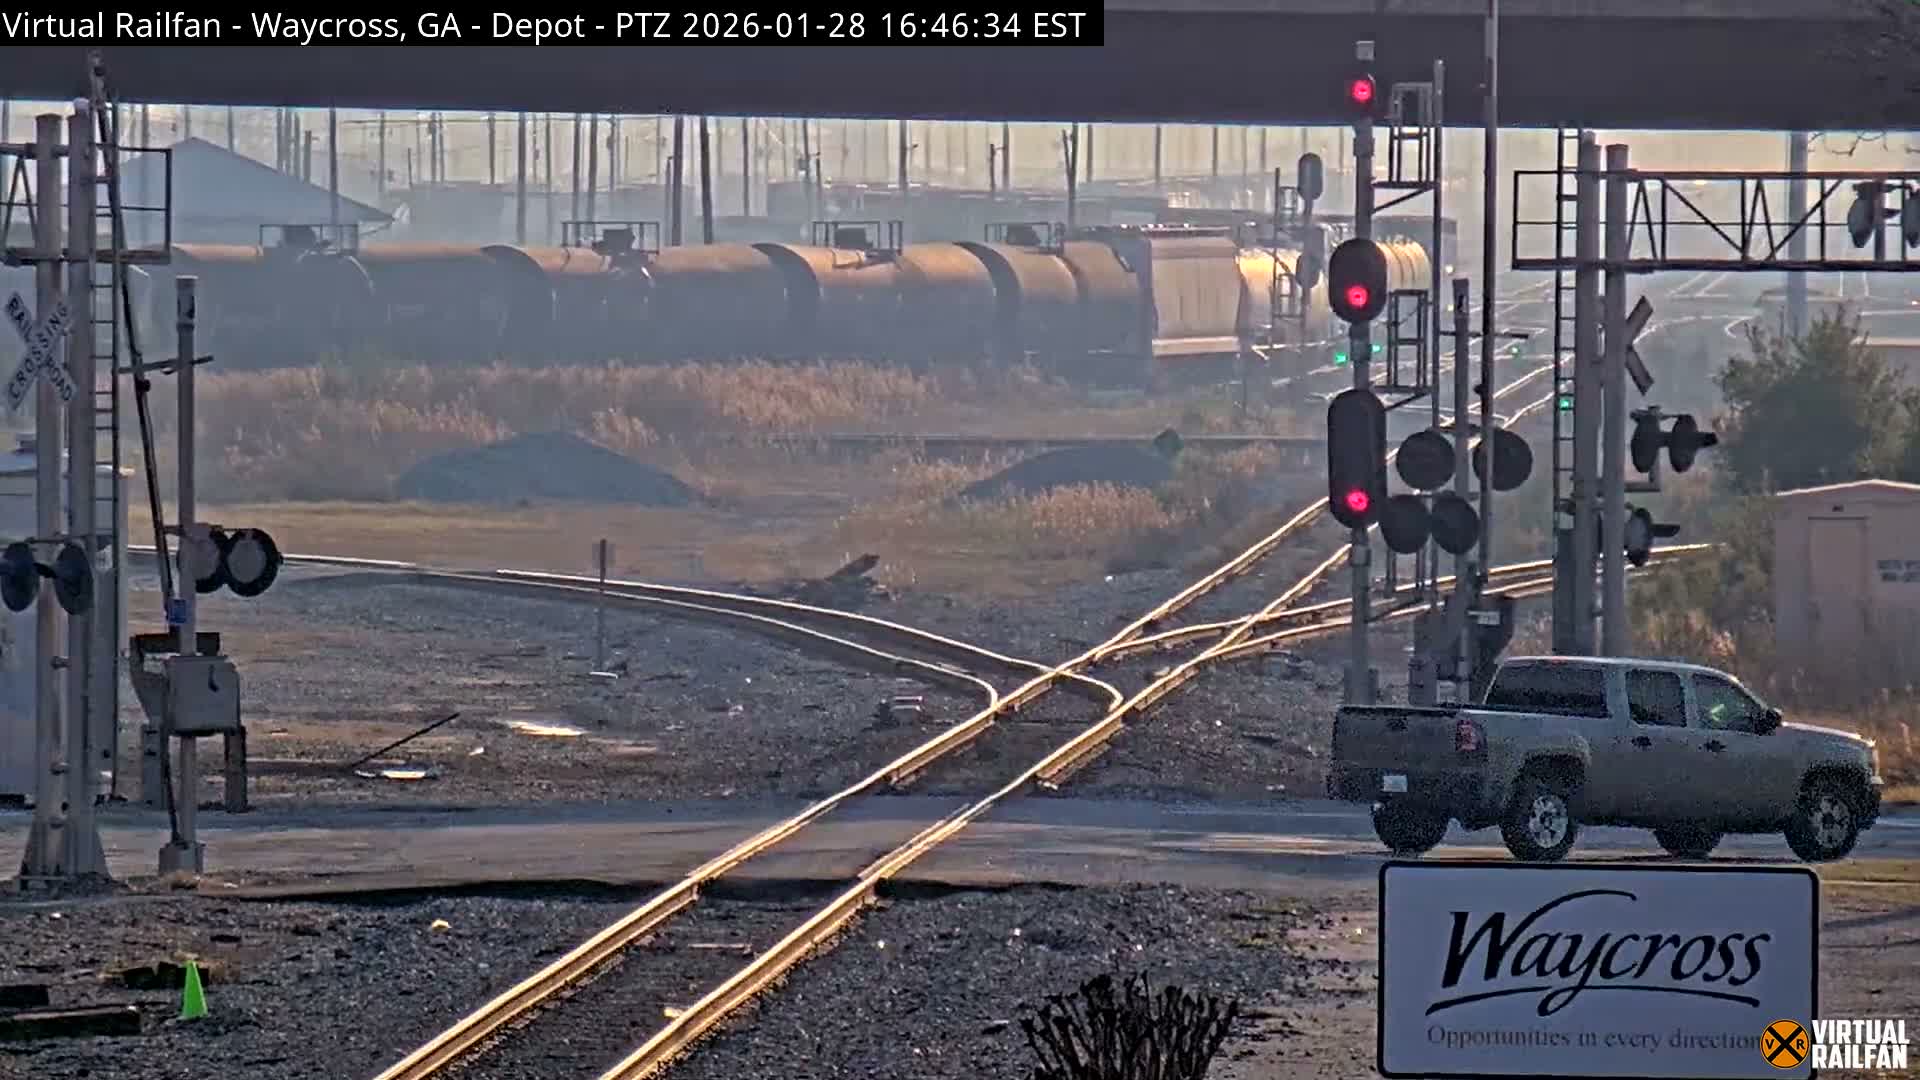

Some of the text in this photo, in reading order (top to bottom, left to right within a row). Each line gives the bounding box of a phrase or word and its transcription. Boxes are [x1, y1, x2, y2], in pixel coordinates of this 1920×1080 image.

[9, 301, 69, 399] CROSSING
[1441, 889, 1772, 1017] Waycross
[1427, 1024, 1571, 1050] Opportunities
[1577, 1031, 1597, 1048] in
[1604, 1031, 1662, 1054] every
